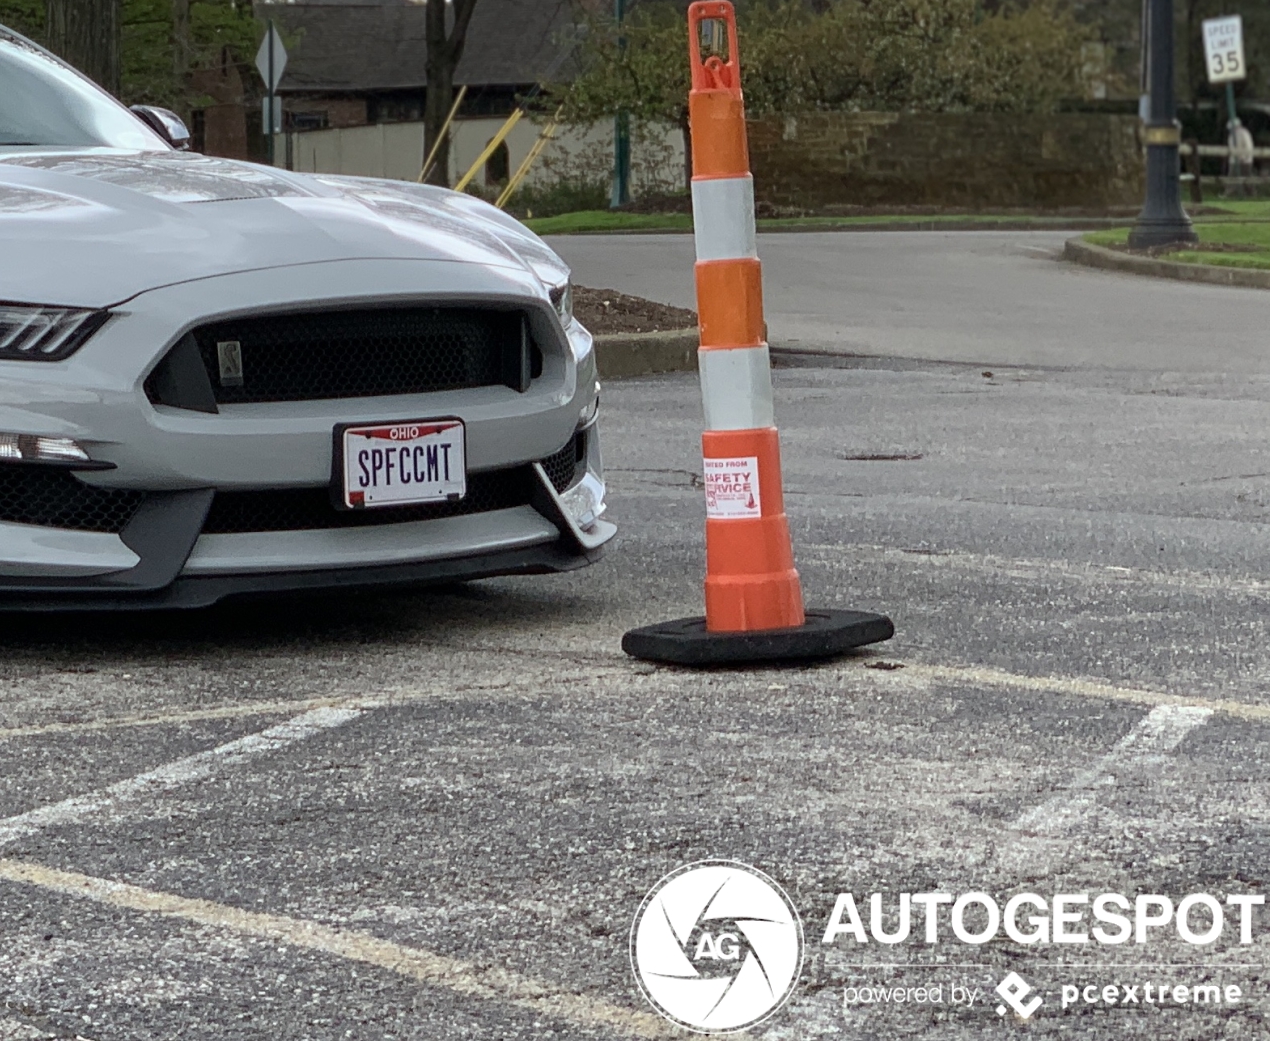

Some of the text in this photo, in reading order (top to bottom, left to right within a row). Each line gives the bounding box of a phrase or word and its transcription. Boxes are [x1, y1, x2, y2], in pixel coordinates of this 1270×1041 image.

[1208, 24, 1237, 36] SPEED
[1211, 37, 1235, 50] LIMIT
[1212, 51, 1240, 74] 35
[390, 427, 419, 440] OHIO
[358, 443, 452, 488] SPFCCMT
